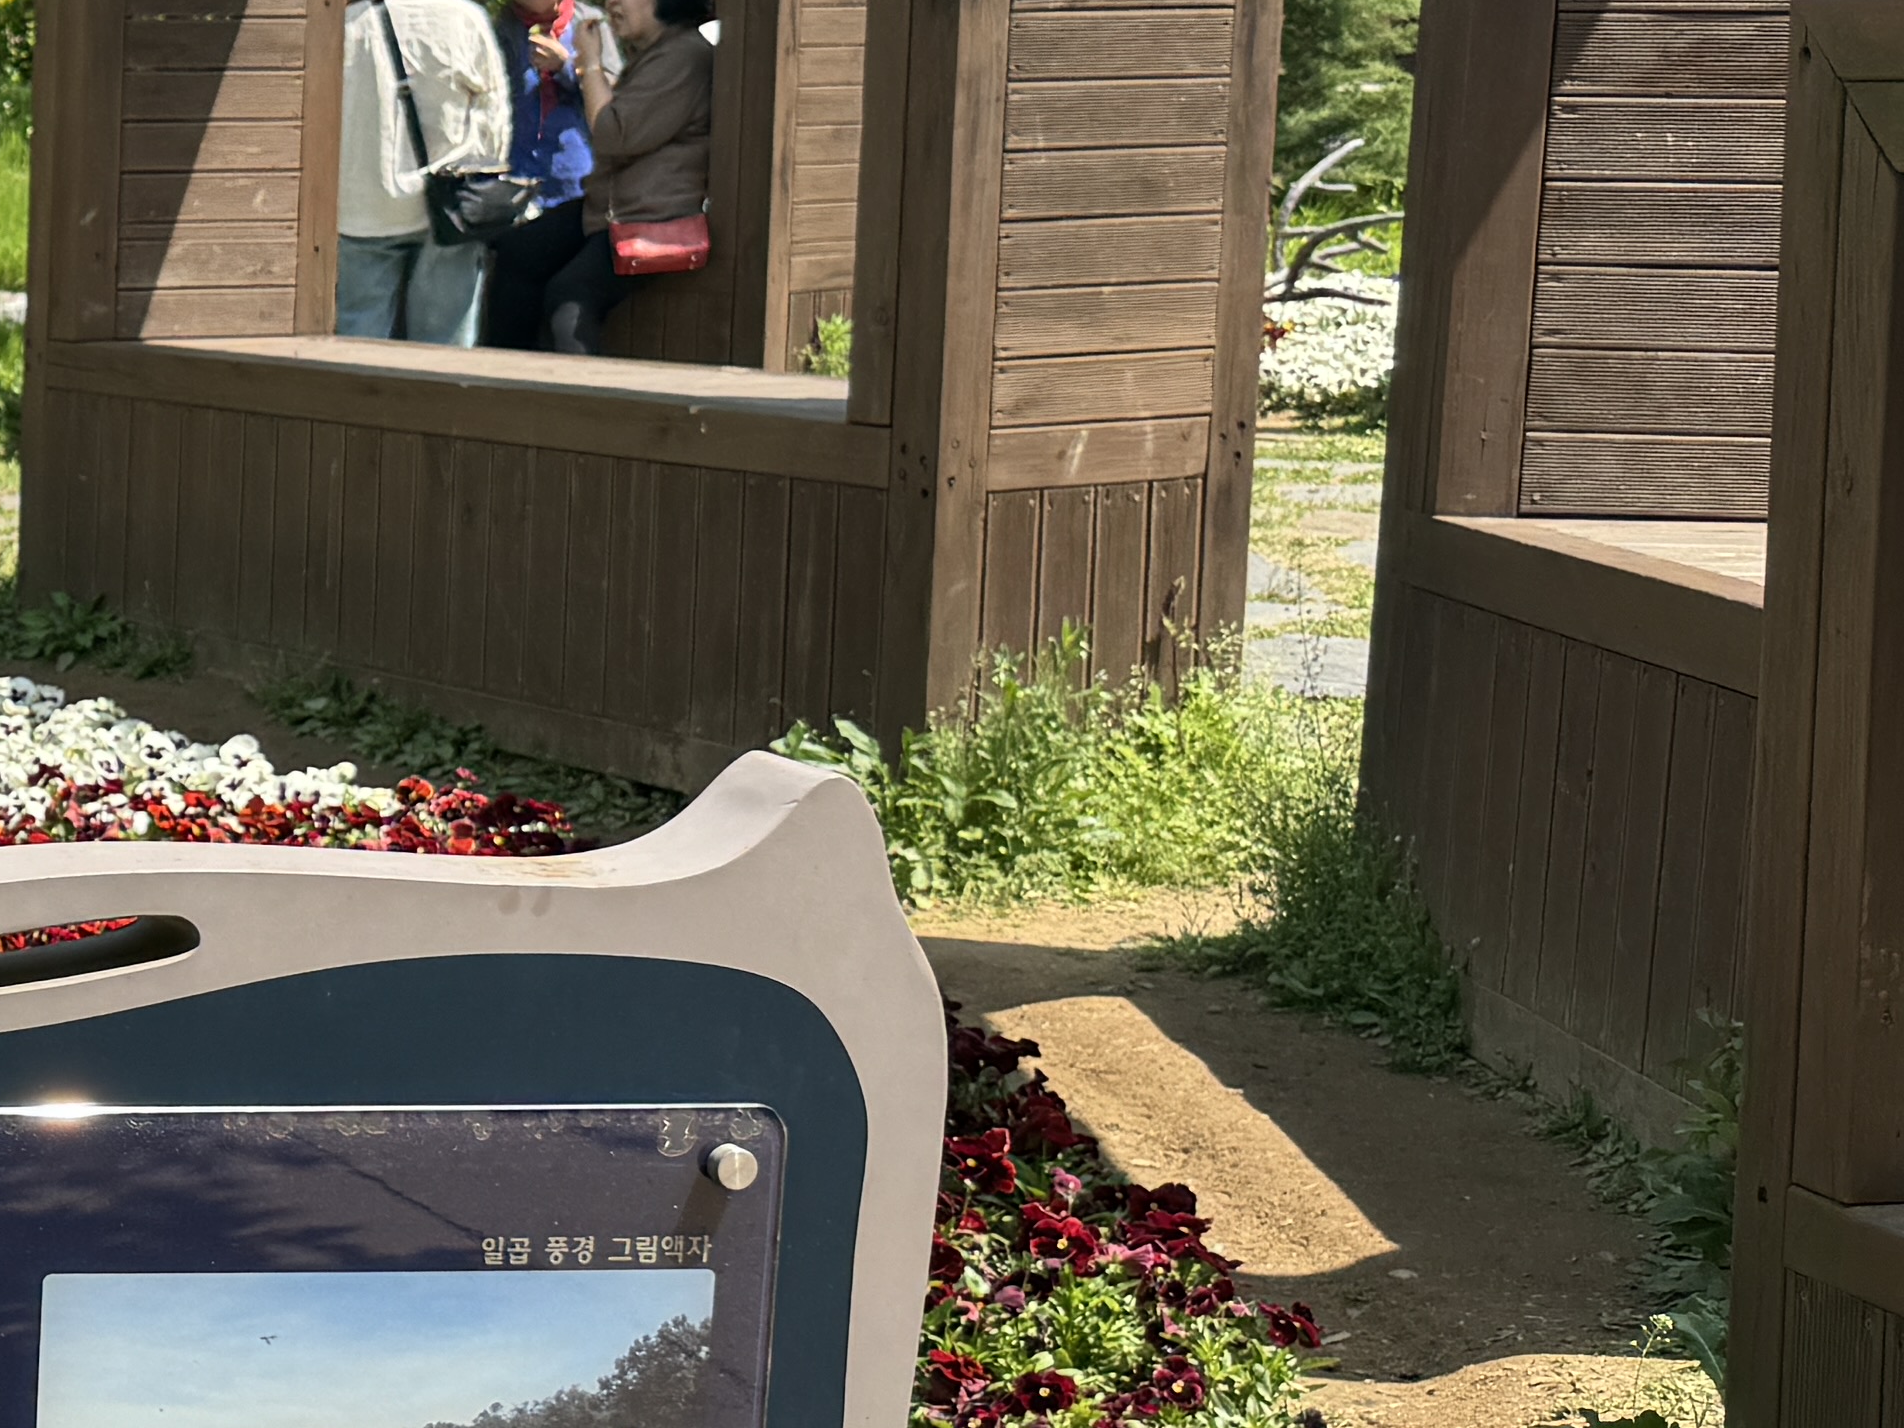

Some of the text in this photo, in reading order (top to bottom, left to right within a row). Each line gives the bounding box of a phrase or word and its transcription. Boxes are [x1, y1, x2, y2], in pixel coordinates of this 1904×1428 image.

[481, 1235, 713, 1265] 일곱 풍경 그림액자
